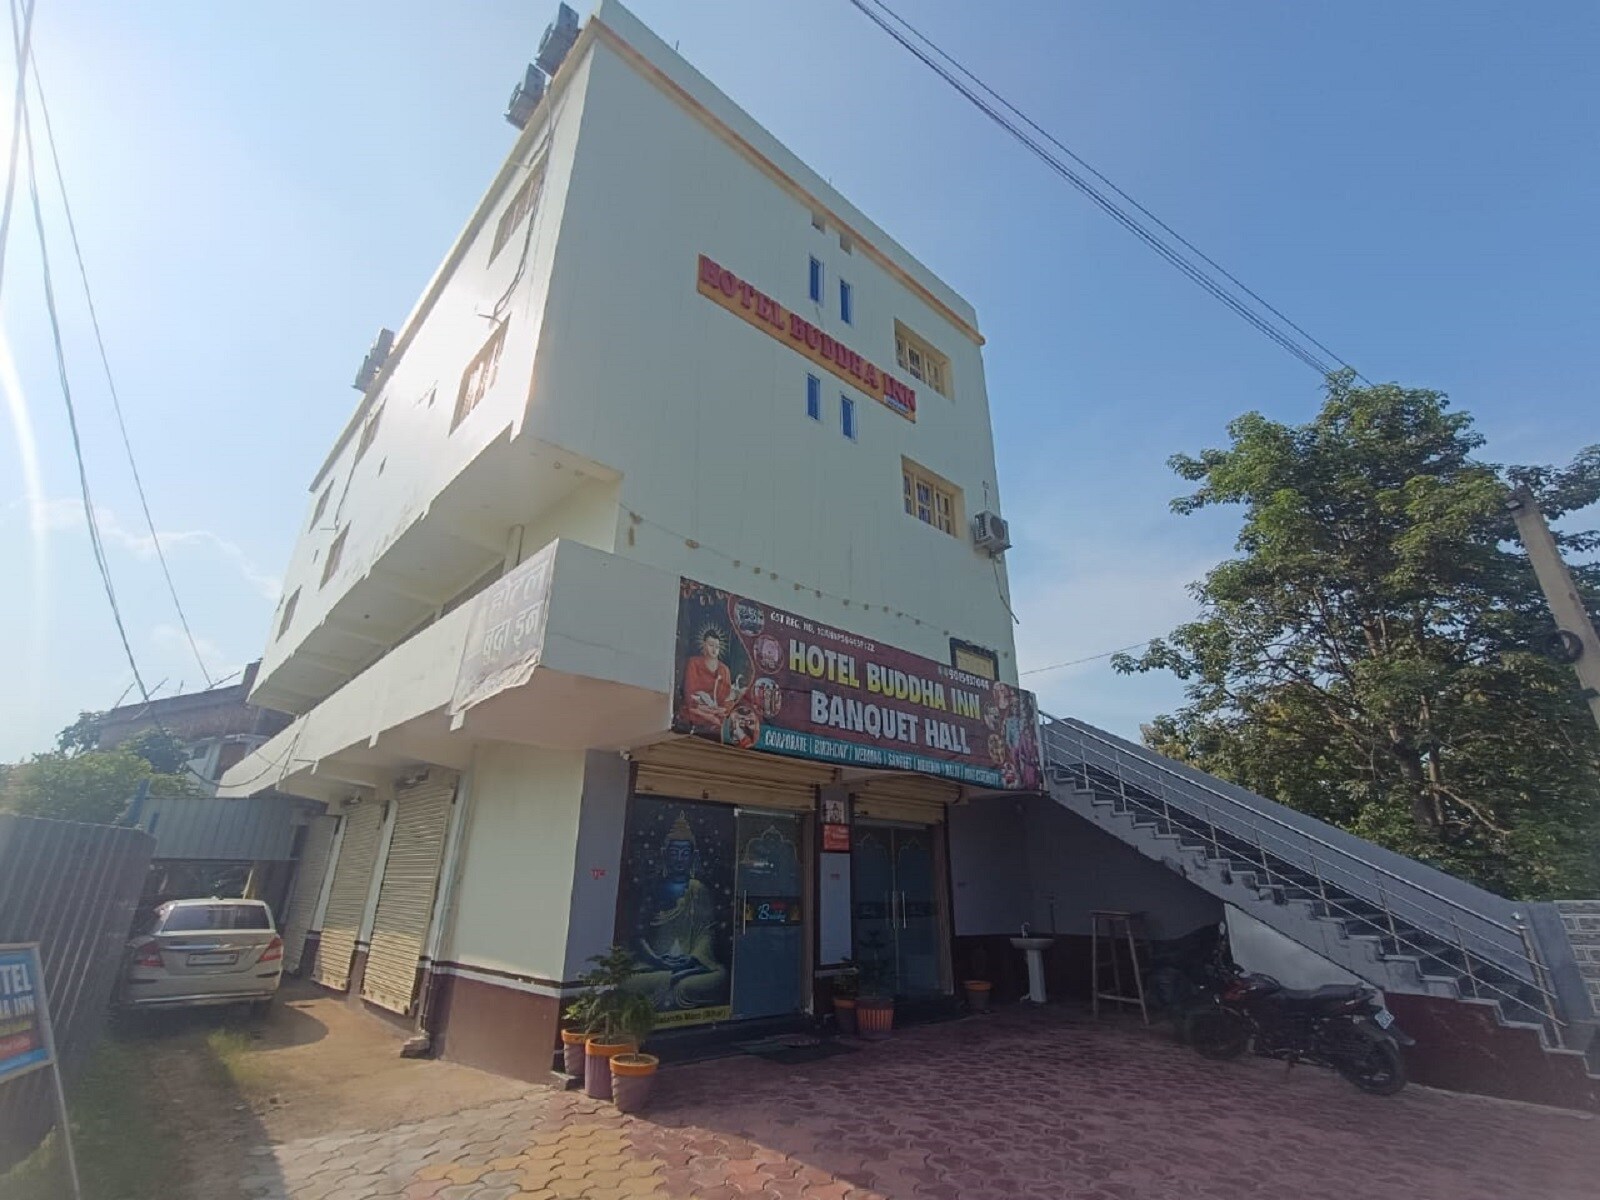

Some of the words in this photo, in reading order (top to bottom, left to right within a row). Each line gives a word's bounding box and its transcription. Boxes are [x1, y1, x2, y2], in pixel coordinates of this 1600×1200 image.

[699, 255, 785, 331] HOTEL
[789, 312, 879, 389] BUDDHA
[883, 372, 916, 412] INN
[770, 611, 784, 624] GST
[788, 638, 860, 689] HOTEL
[867, 662, 947, 712] BUDDHA
[950, 687, 981, 721] INN
[765, 730, 807, 752] CORPORATE
[810, 690, 919, 745] BANQUET
[925, 718, 971, 755] HALL
